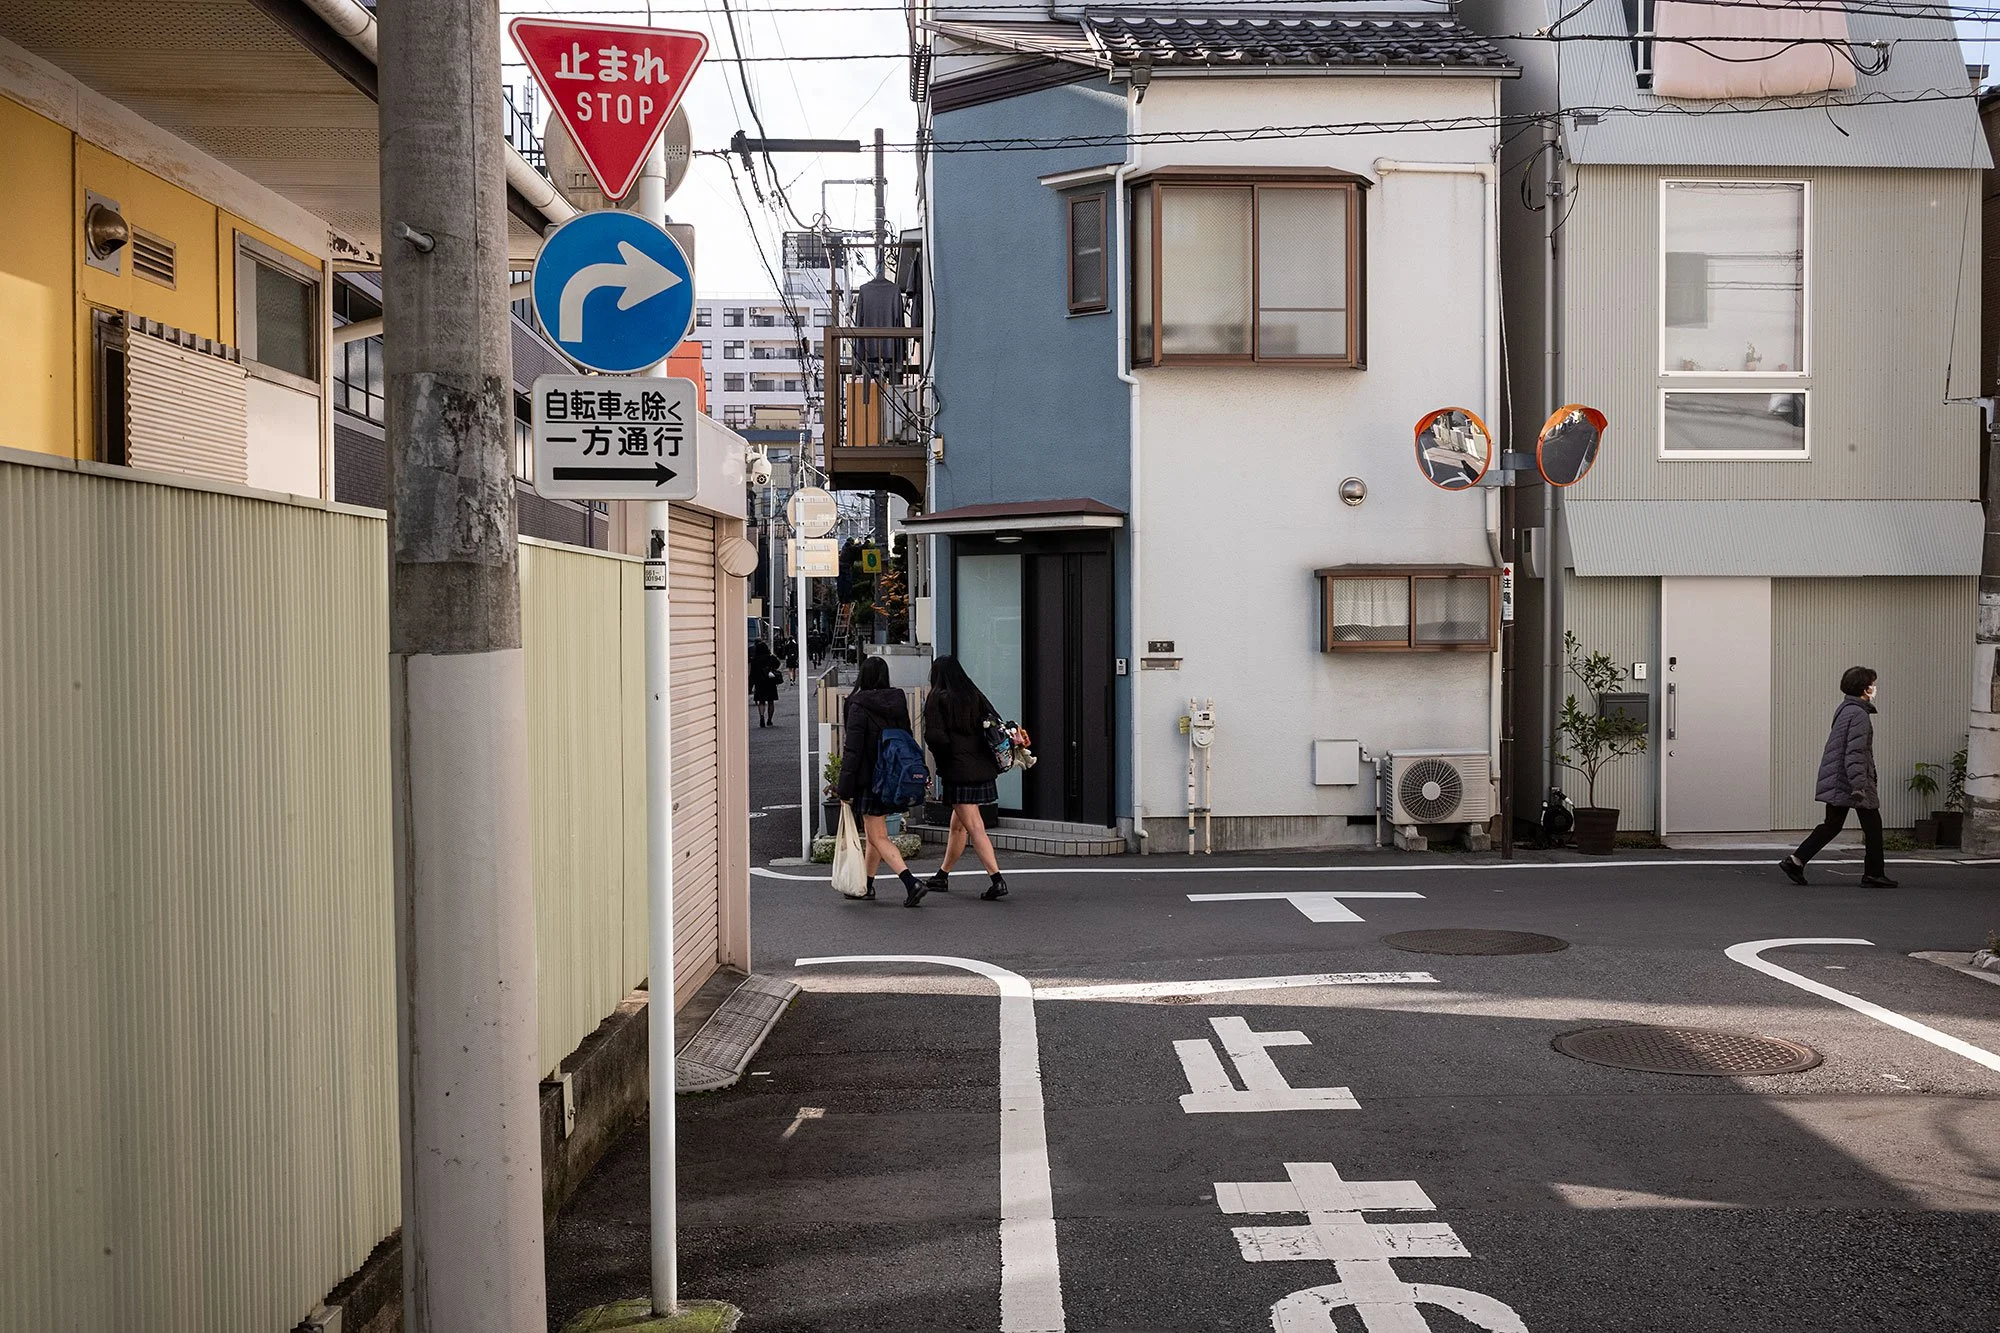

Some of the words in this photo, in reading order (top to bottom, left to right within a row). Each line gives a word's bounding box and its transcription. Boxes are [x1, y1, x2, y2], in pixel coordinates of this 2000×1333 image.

[555, 42, 670, 85] 止まれ
[577, 91, 654, 125] STOP
[545, 388, 682, 422] 自転車を除く
[546, 425, 684, 457] 一方通行
